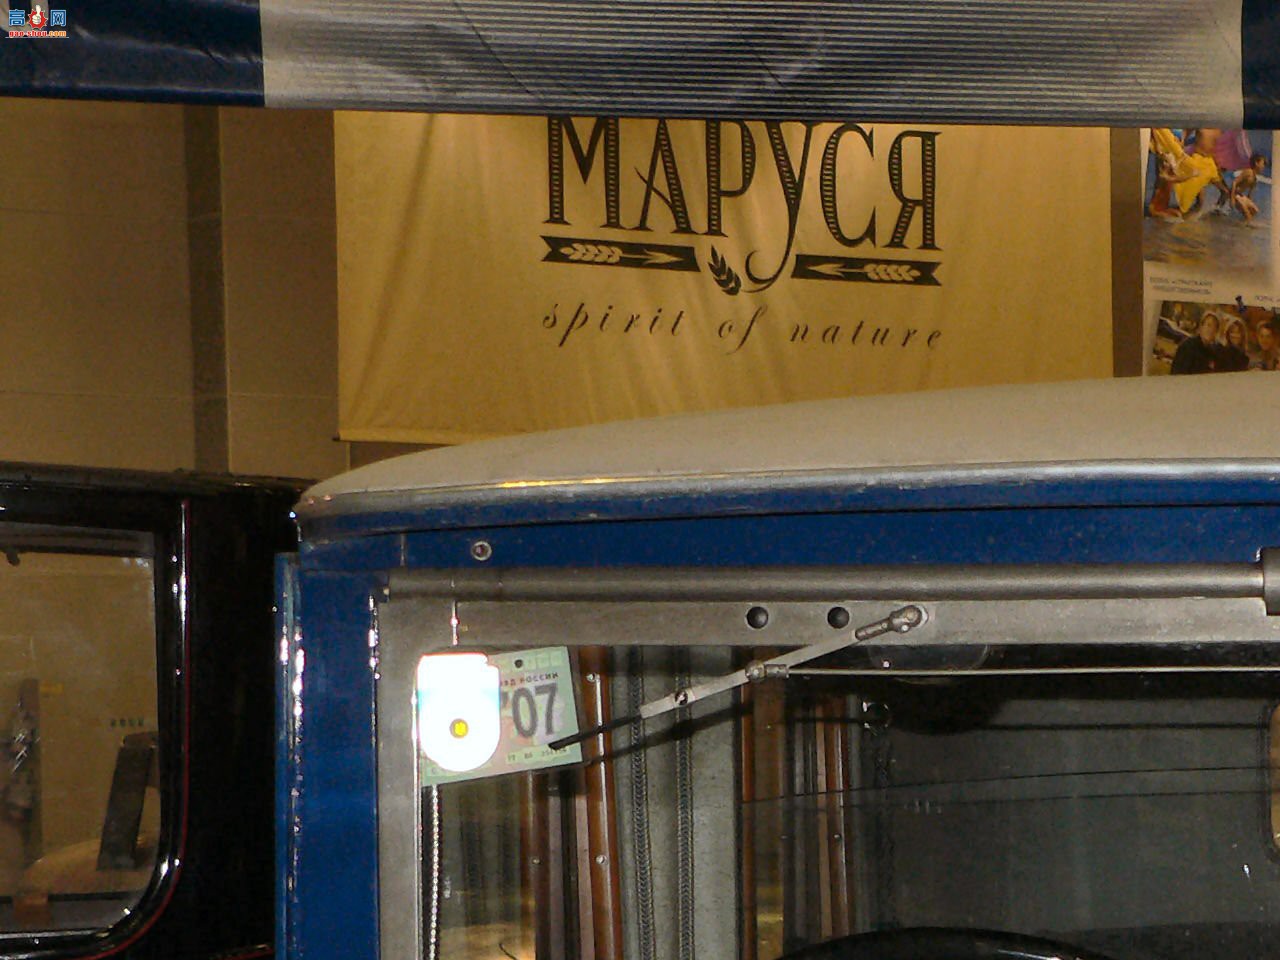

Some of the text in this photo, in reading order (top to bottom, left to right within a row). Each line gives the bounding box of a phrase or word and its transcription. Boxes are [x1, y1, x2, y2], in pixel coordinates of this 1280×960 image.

[542, 114, 943, 293] МАРУСЯ
[542, 302, 943, 355] spirit of nature
